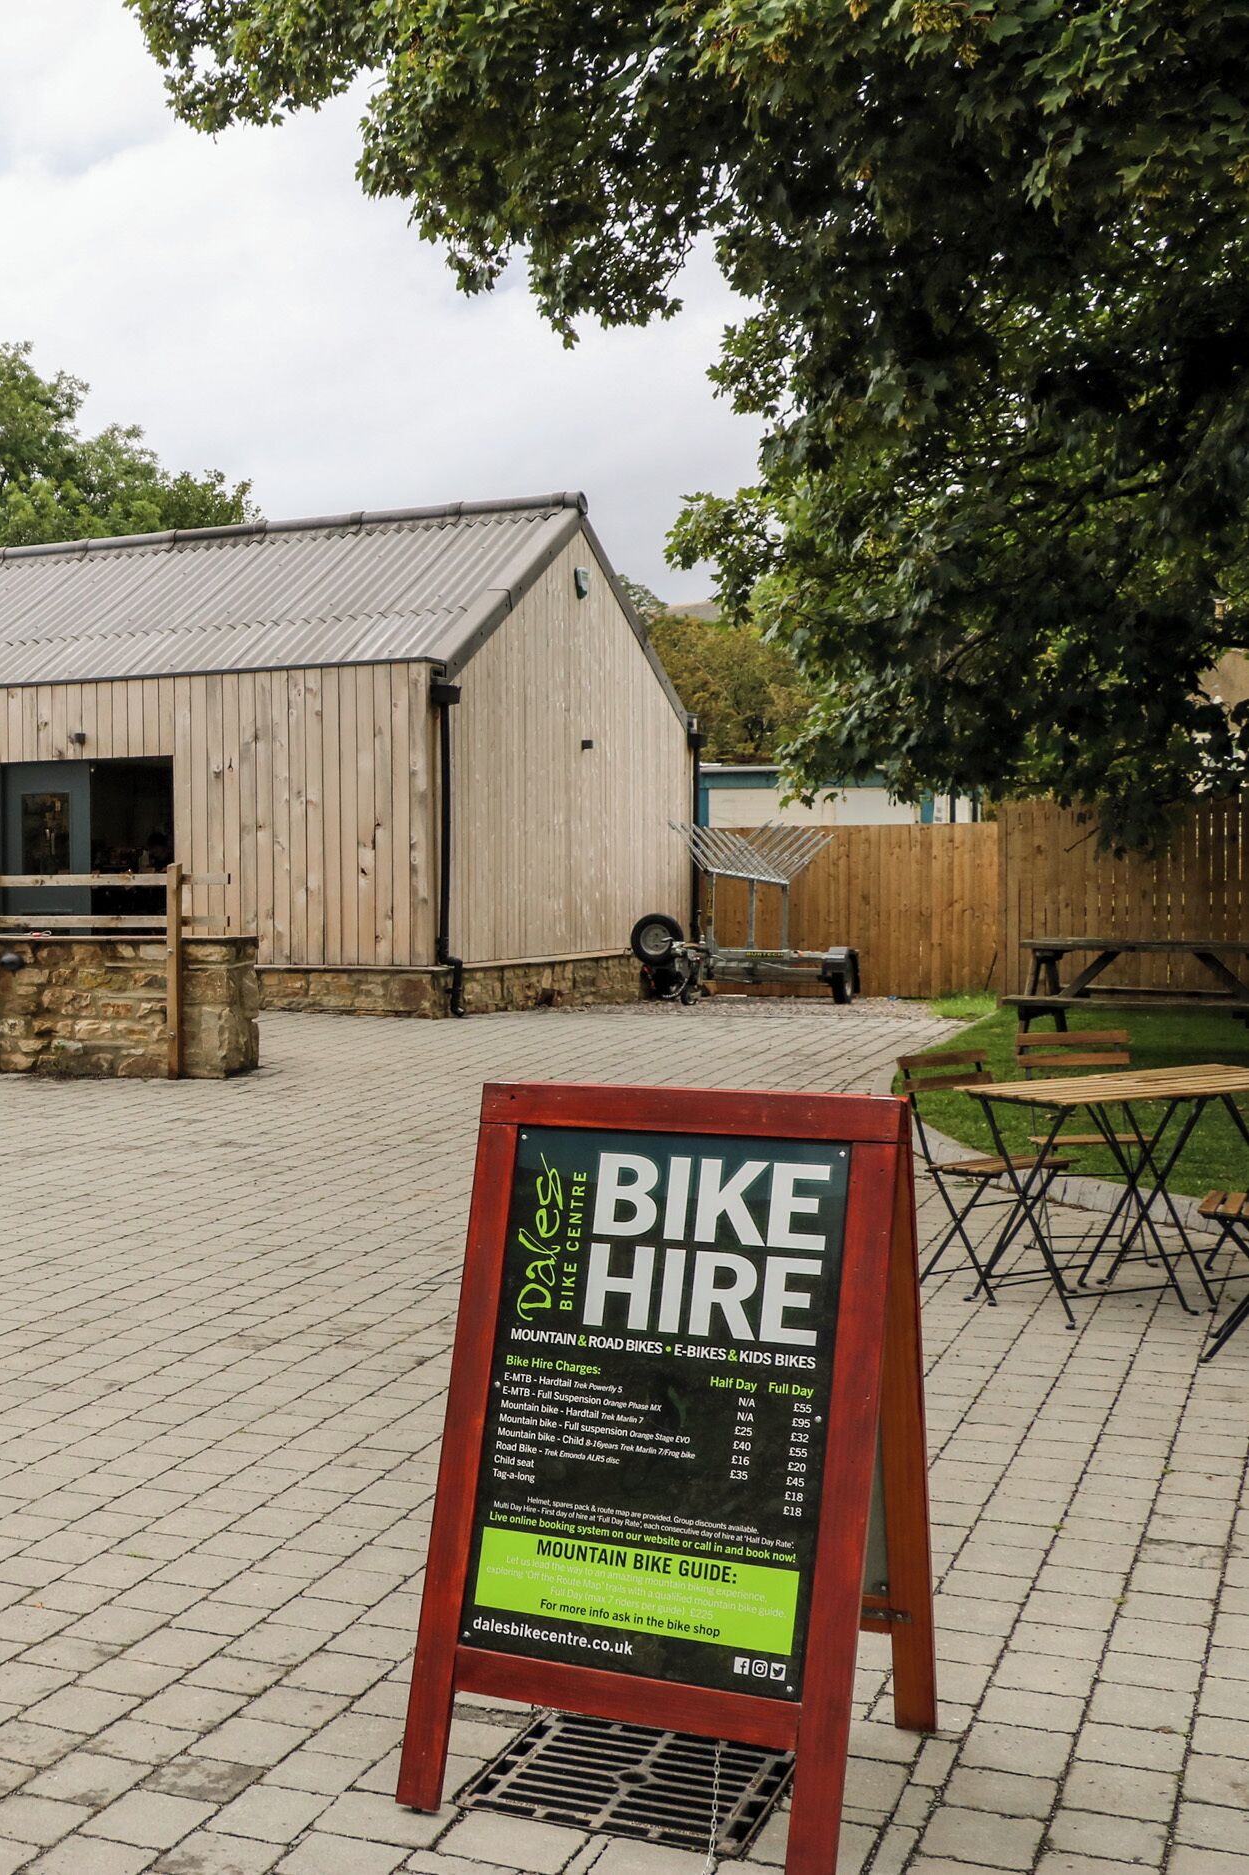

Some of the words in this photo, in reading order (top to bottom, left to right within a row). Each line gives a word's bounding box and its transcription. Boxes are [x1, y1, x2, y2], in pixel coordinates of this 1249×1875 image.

[566, 1171, 587, 1251] CENTRE
[592, 1152, 831, 1251] BIKE
[517, 1152, 563, 1321] Dales
[560, 1258, 577, 1311] BIKE
[582, 1243, 822, 1347] HIRE
[506, 1354, 529, 1366] Bike
[531, 1357, 553, 1369] Hire
[555, 1360, 601, 1375] Charges:
[510, 1328, 576, 1345] MOUNTAIN
[588, 1335, 623, 1349] ROAD
[625, 1339, 663, 1354] BIKES
[674, 1344, 726, 1360] E-BIKES
[739, 1350, 771, 1365] KIDS
[774, 1353, 815, 1369] BIKES
[504, 1372, 531, 1383] E-MTB
[538, 1375, 572, 1387] Hardtail
[573, 1381, 587, 1389] Trek
[588, 1382, 617, 1393] Powerfly
[617, 1385, 622, 1393] 5
[738, 1397, 755, 1407] N/A
[793, 1403, 812, 1413] £55
[710, 1376, 734, 1388] Half
[735, 1378, 757, 1392] Day
[768, 1382, 788, 1394] Full
[791, 1384, 813, 1399] Day
[500, 1399, 539, 1412] Mountain
[541, 1404, 558, 1414] bike
[565, 1407, 599, 1418] Hardtail
[601, 1412, 614, 1420] Trek
[615, 1414, 637, 1423] Marlin
[734, 1426, 752, 1436] £25
[790, 1432, 809, 1443] £32
[502, 1385, 530, 1396] E-MTB
[537, 1389, 552, 1399] Full
[553, 1391, 601, 1404] Suspension
[603, 1398, 627, 1408] Orange
[627, 1401, 649, 1410] Phase
[737, 1411, 754, 1421] N/A
[791, 1417, 810, 1428] £95
[497, 1426, 536, 1439] Mountain
[537, 1431, 555, 1442] bike
[562, 1434, 584, 1445] Child
[620, 1443, 634, 1451] Trek
[635, 1445, 657, 1454] Marlin
[658, 1447, 680, 1458] 7/Frog
[680, 1451, 695, 1459] bike
[731, 1455, 749, 1465] £16
[787, 1461, 806, 1472] £20
[499, 1413, 537, 1425] Mountain
[539, 1418, 557, 1428] bike
[564, 1420, 579, 1430] Full
[580, 1424, 628, 1436] suspension
[629, 1430, 653, 1440] Orange
[654, 1433, 674, 1442] Stage
[675, 1435, 690, 1444] EVO
[732, 1440, 751, 1451] £40
[789, 1447, 807, 1457] £55
[494, 1454, 515, 1465] Child
[516, 1459, 534, 1468] seat
[784, 1491, 803, 1501] £18
[495, 1440, 517, 1451] Road
[518, 1443, 537, 1454] Bike
[544, 1448, 558, 1456] Trek
[559, 1450, 586, 1460] Emonda
[605, 1456, 620, 1464] disc
[729, 1469, 748, 1480] £35
[786, 1476, 804, 1487] £45
[493, 1468, 535, 1483] Tag-a-long
[782, 1506, 802, 1516] £18
[489, 1511, 507, 1522] Live
[509, 1515, 537, 1526] online
[538, 1518, 575, 1533] booking
[577, 1525, 609, 1536] system
[611, 1530, 623, 1538] on
[625, 1532, 642, 1541] our
[643, 1534, 680, 1546] website
[682, 1540, 692, 1548] or
[694, 1541, 711, 1551] call
[713, 1542, 722, 1552] in
[724, 1546, 743, 1555] and
[745, 1547, 770, 1559] book
[772, 1553, 796, 1562] now!
[493, 1500, 509, 1509] Multi
[510, 1503, 522, 1512] Day
[523, 1505, 536, 1513] Hire
[541, 1507, 555, 1515] First
[555, 1509, 567, 1518] day
[575, 1512, 588, 1520] hire
[611, 1516, 623, 1526] Day
[660, 1525, 699, 1536] consecutive
[700, 1529, 713, 1538] day
[721, 1532, 735, 1540] hire
[761, 1537, 774, 1547] Day
[552, 1501, 573, 1509] spares
[590, 1504, 596, 1512] &
[615, 1509, 630, 1517] map
[642, 1513, 672, 1522] provided.
[673, 1515, 694, 1526] Group
[694, 1519, 726, 1529] discounts
[536, 1539, 627, 1567] MOUNTAIN
[633, 1553, 672, 1574] BIKE
[678, 1560, 737, 1583] GUIDE:
[473, 1616, 632, 1655] dalesbikecentre.co.uk
[540, 1598, 557, 1610] For
[559, 1604, 586, 1615] more
[589, 1606, 609, 1619] info
[612, 1612, 630, 1622] ask
[633, 1613, 643, 1624] in
[646, 1616, 664, 1627] the
[667, 1618, 690, 1632] bike
[693, 1624, 720, 1638] shop
